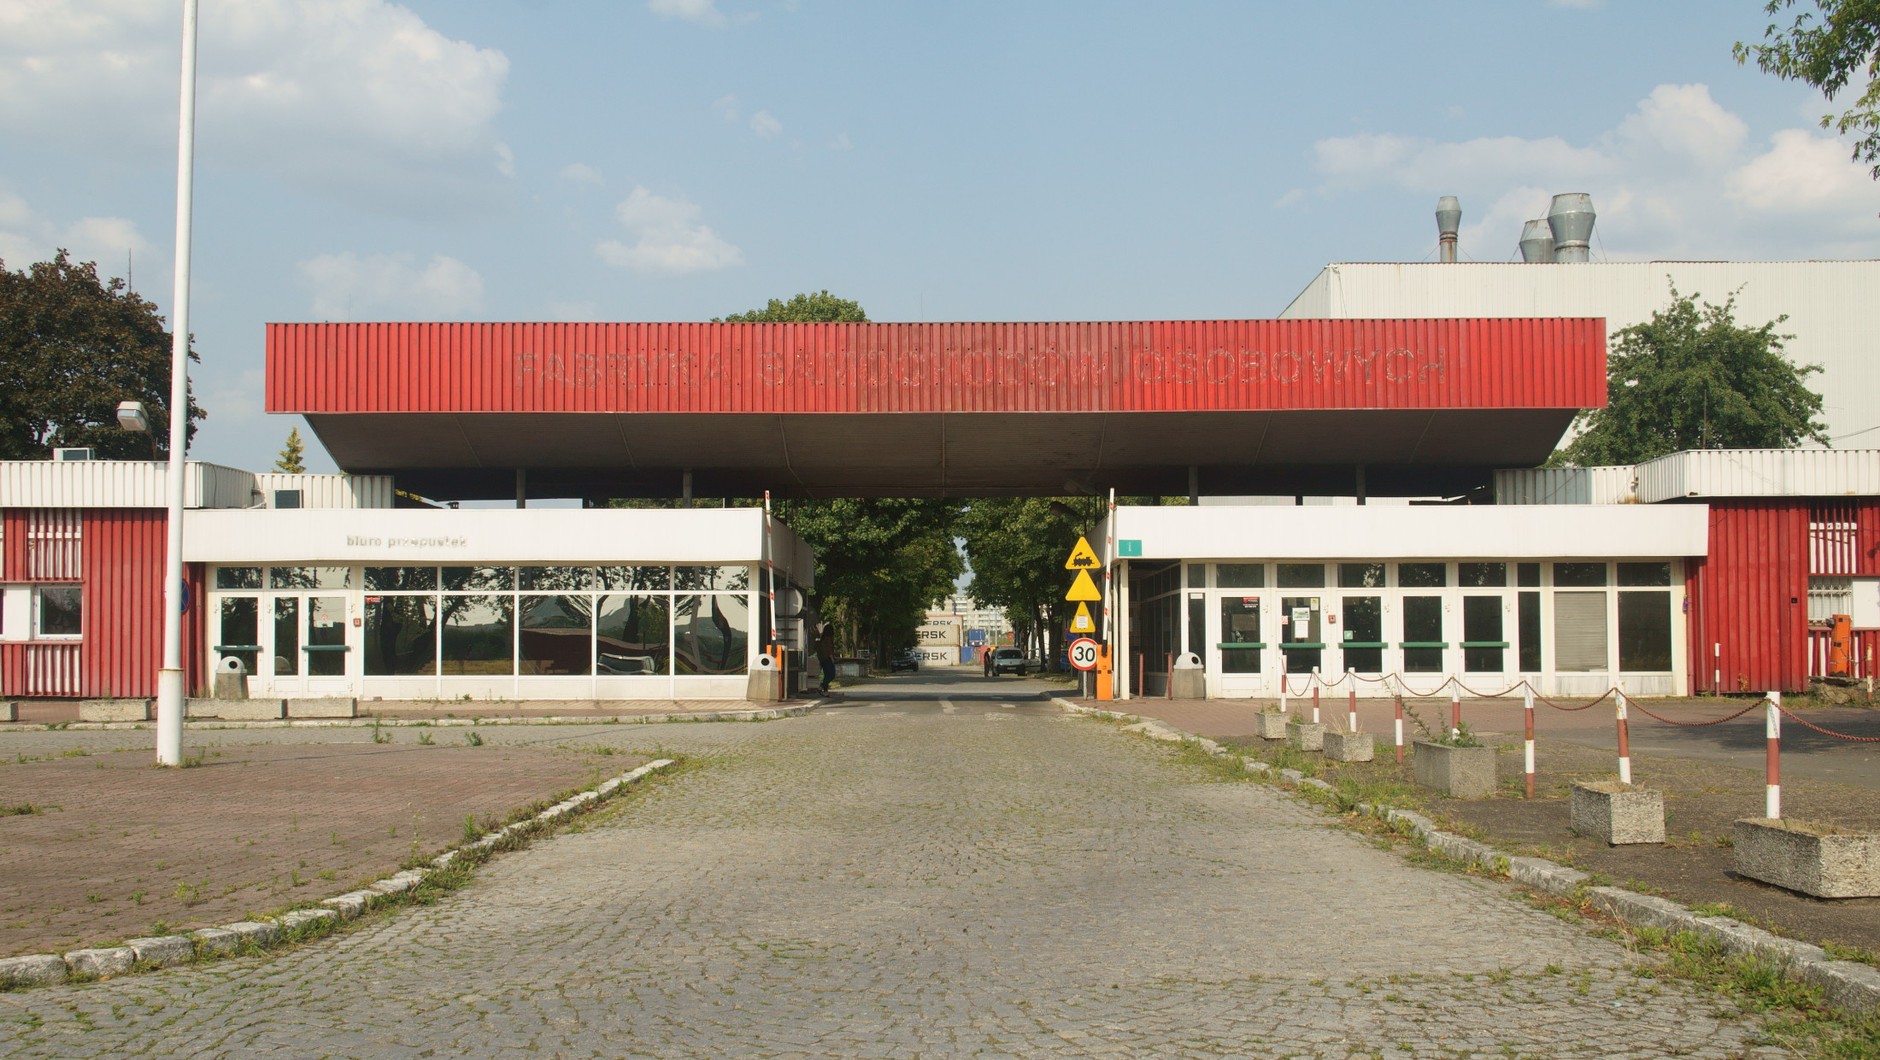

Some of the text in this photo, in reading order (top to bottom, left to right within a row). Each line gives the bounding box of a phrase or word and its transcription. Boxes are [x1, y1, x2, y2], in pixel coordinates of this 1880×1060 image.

[1134, 348, 1446, 385] OSOBOWYCH
[915, 630, 947, 639] ERSK
[915, 652, 948, 661] ERSK
[1074, 646, 1096, 662] 30
